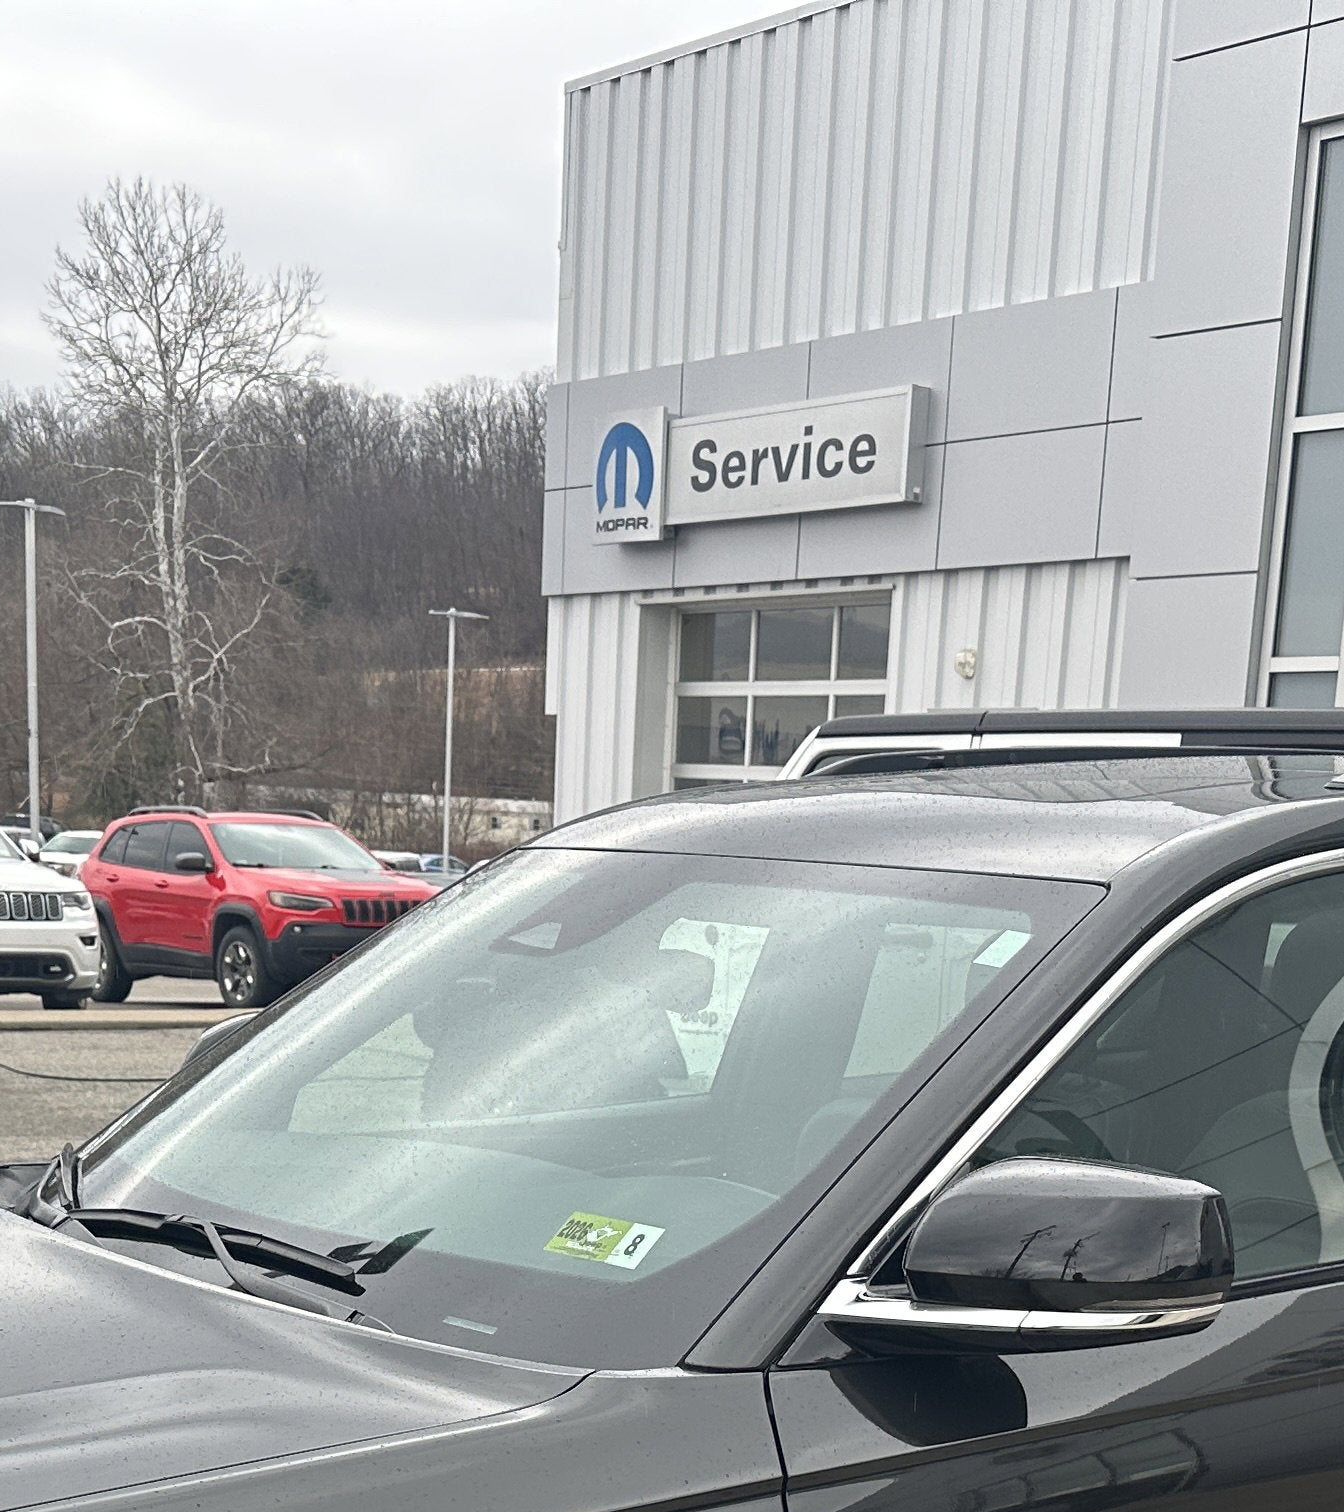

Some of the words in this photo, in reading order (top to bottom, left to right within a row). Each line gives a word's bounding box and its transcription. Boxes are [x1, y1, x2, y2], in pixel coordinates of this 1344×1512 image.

[690, 425, 877, 493] Service
[596, 516, 649, 533] MOPAR
[557, 1219, 594, 1241] 2026
[623, 1233, 646, 1256] 8
